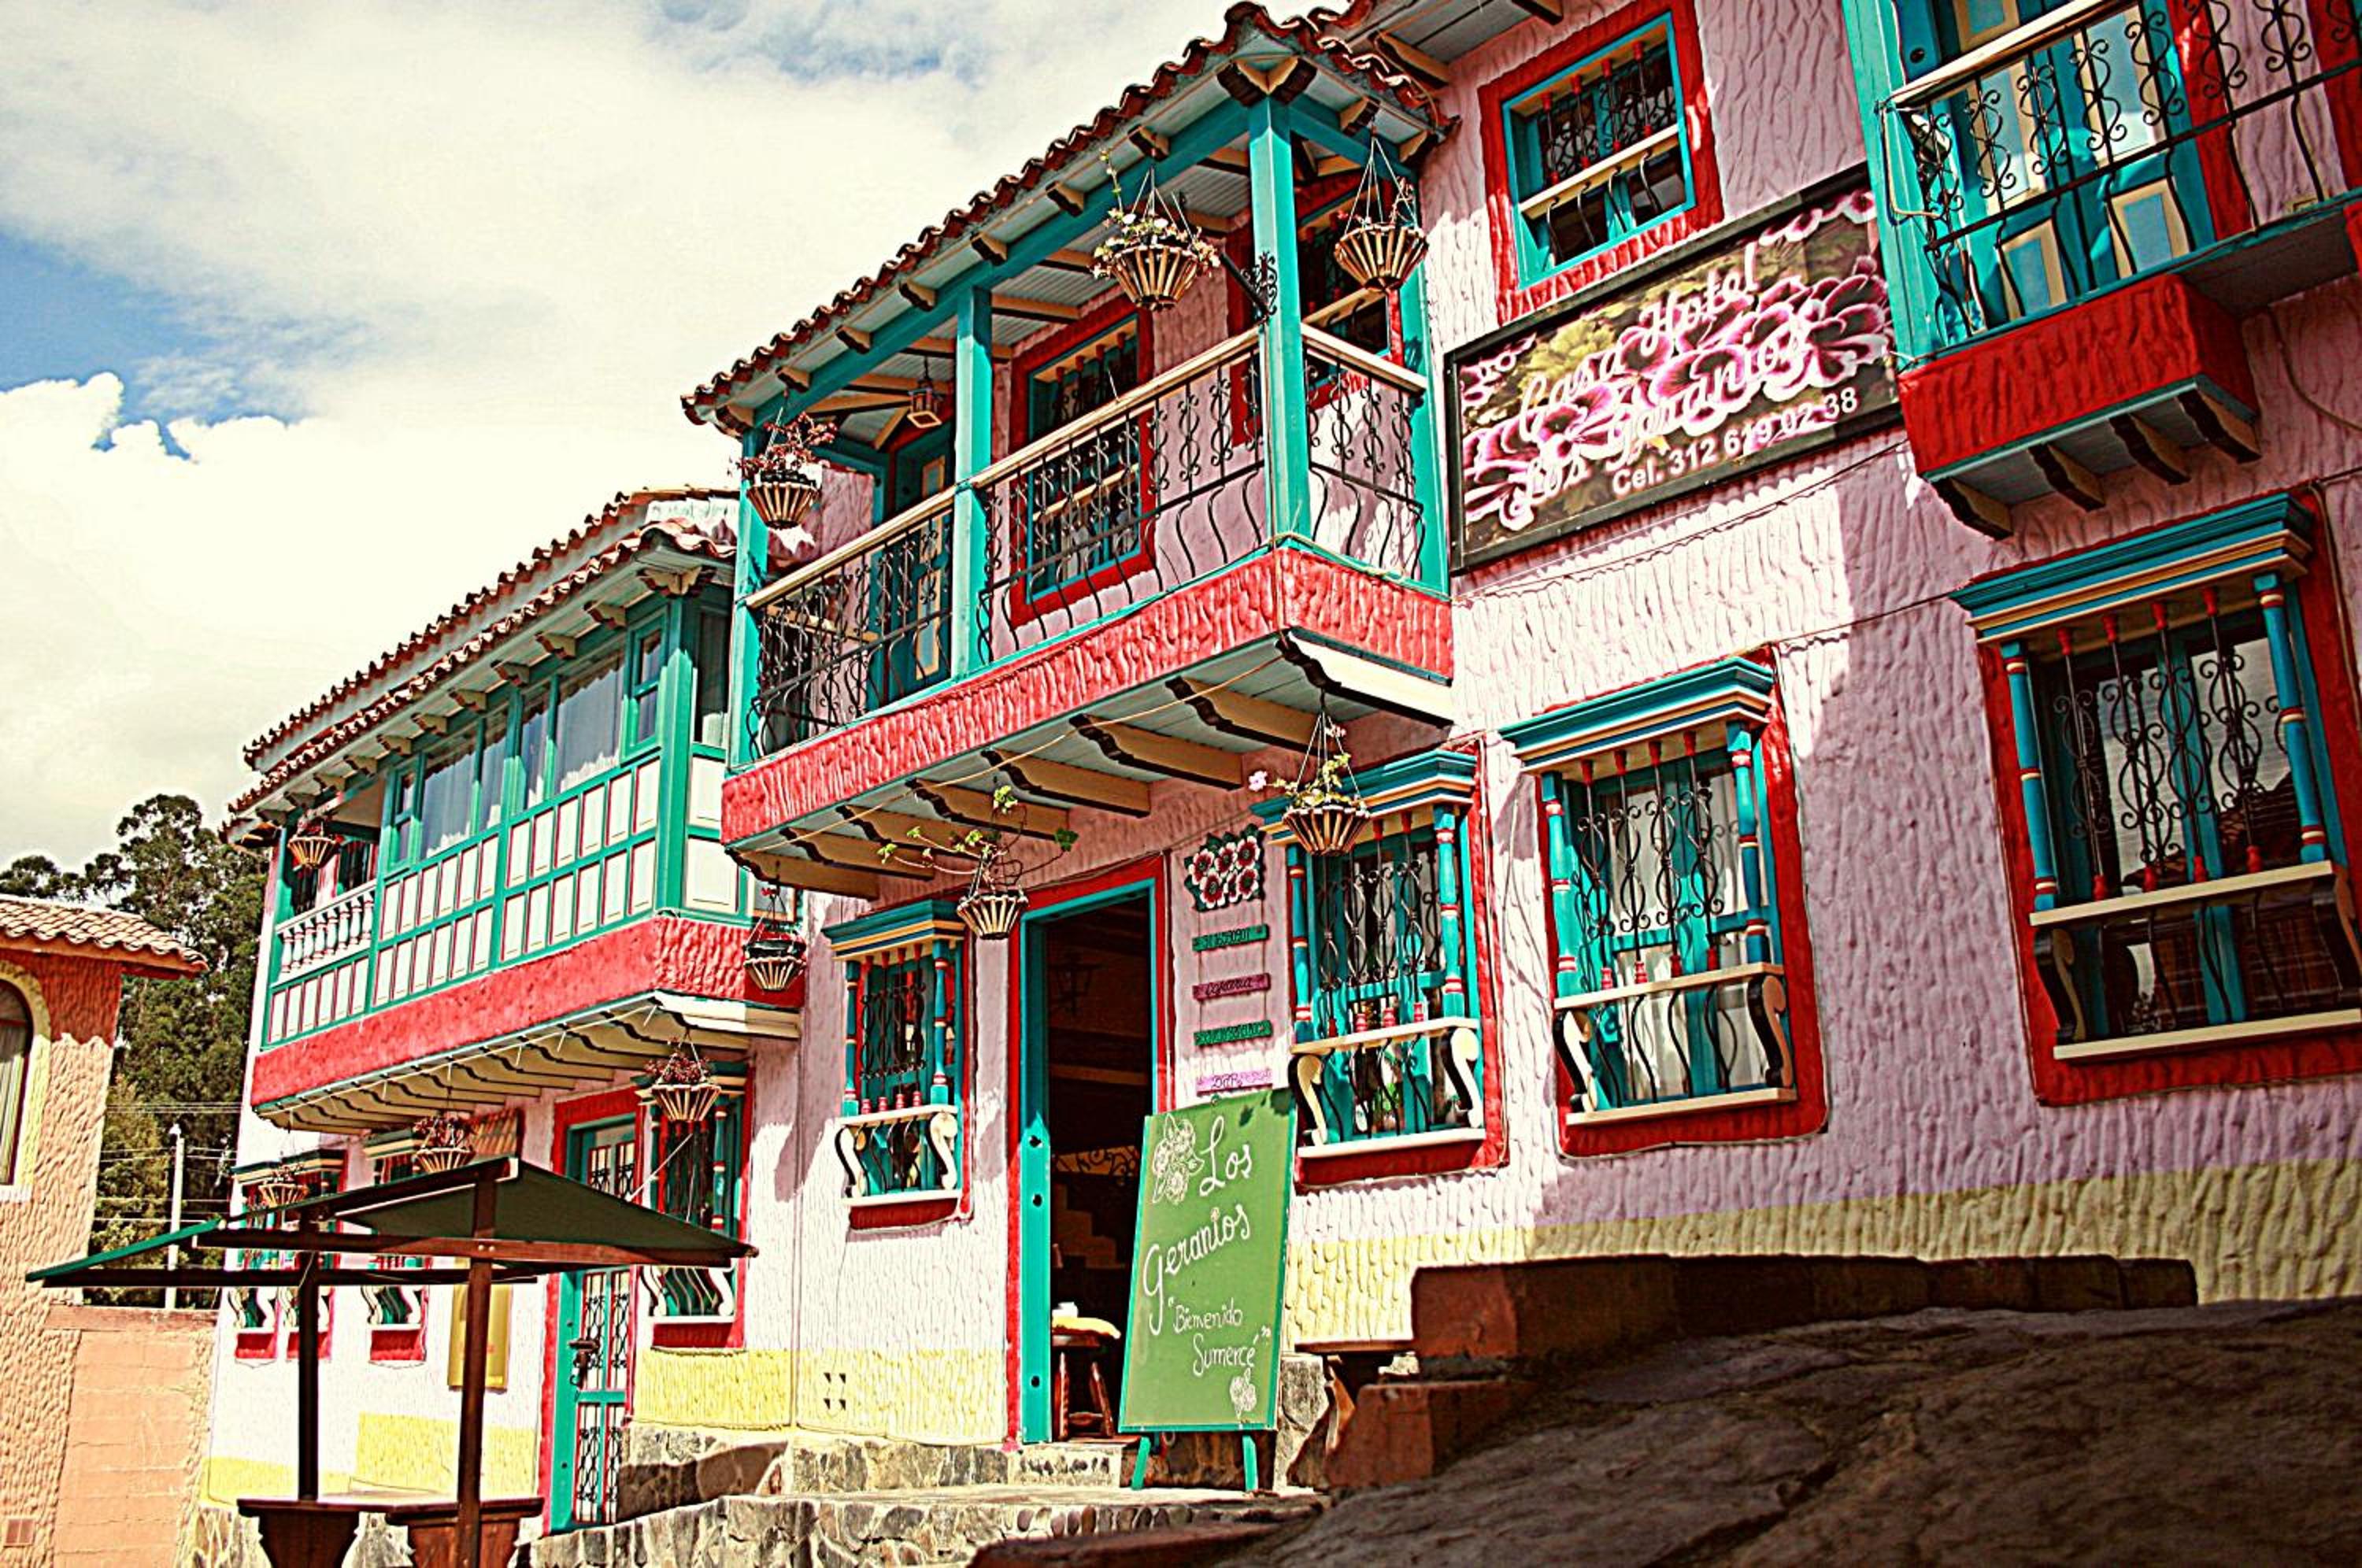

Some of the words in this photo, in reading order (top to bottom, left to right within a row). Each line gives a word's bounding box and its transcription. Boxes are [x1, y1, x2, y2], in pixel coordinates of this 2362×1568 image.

[1520, 342, 1627, 443] Casa
[1638, 241, 1760, 356] Hotel
[1612, 459, 1663, 496] Cel.
[1669, 438, 1718, 475] 312
[1723, 419, 1773, 457] 619
[1781, 403, 1816, 435] 02
[1824, 386, 1859, 419] 38
[1199, 1115, 1253, 1196] Los
[1143, 1203, 1251, 1336] Geranios
